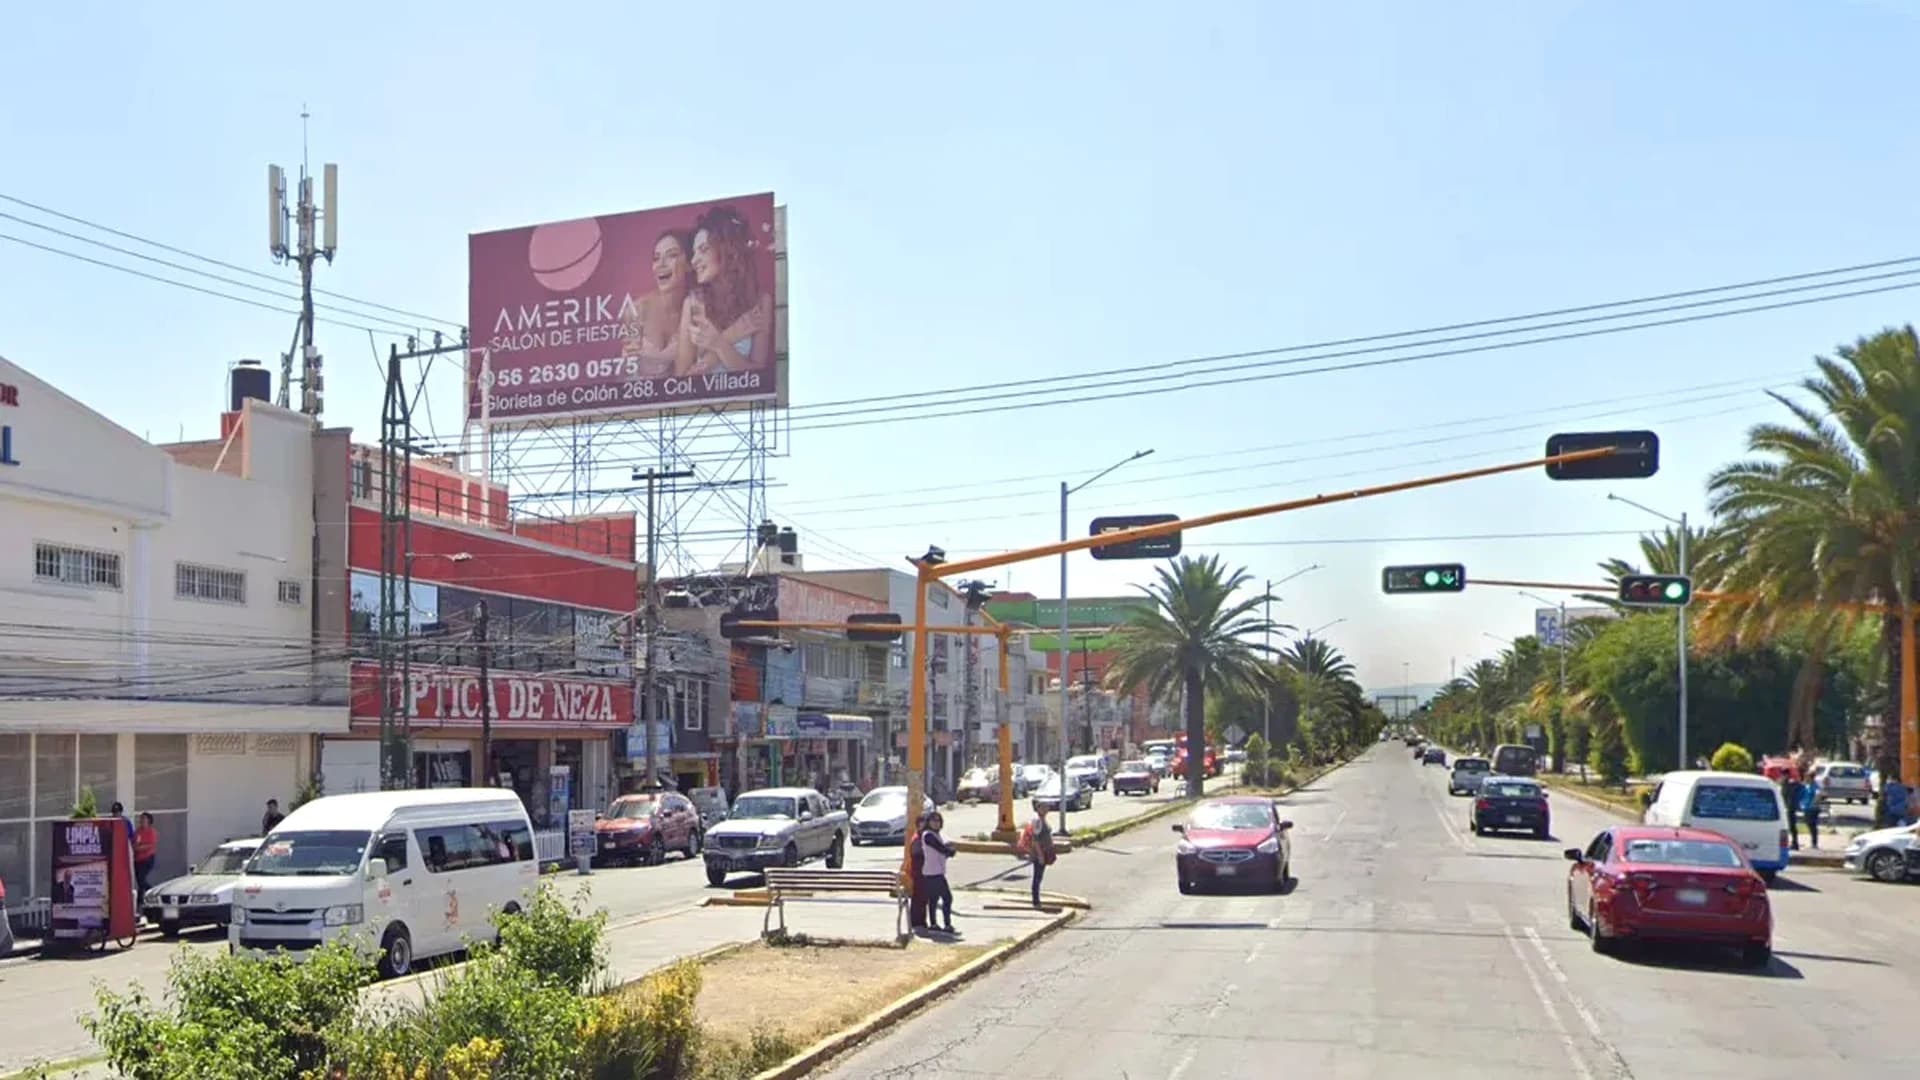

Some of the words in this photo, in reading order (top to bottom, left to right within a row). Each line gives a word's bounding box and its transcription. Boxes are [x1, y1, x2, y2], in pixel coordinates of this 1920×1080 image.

[494, 292, 639, 333] AMERIKA
[491, 331, 546, 353] SALÓN
[550, 329, 573, 347] DE
[577, 323, 640, 343] FIESTAS
[487, 392, 542, 411] Glorieta
[546, 389, 567, 405] de
[571, 383, 618, 404] Colón
[622, 380, 659, 399] 268.
[663, 376, 697, 395] Col.
[703, 371, 761, 392] Villada
[497, 367, 523, 388] 56
[528, 362, 580, 385] 2630
[586, 356, 639, 378] 0575
[507, 679, 545, 720] DE
[552, 682, 617, 722] NEZA
